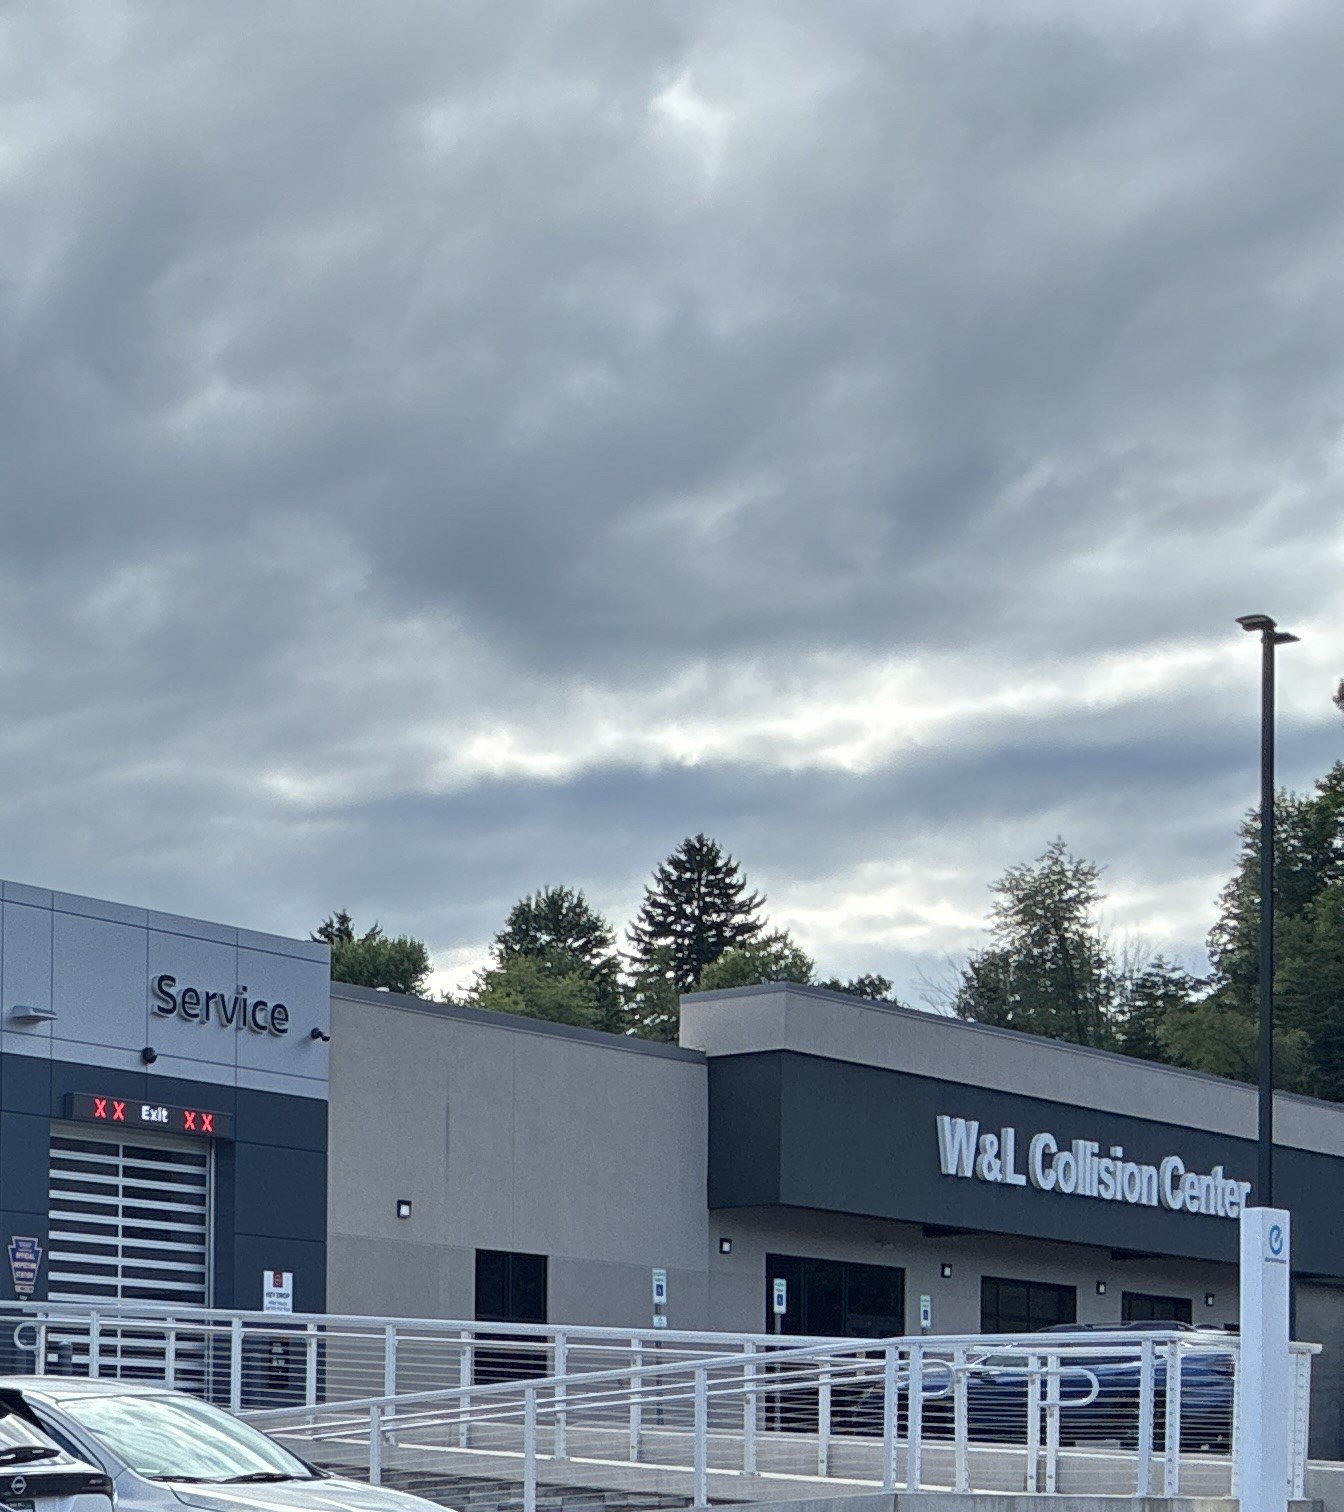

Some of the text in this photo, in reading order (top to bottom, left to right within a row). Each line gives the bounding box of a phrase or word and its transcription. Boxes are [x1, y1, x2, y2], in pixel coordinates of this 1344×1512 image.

[150, 974, 290, 1037] Service
[141, 1105, 168, 1123] Exit
[936, 1115, 1252, 1219] W&L Collision Center
